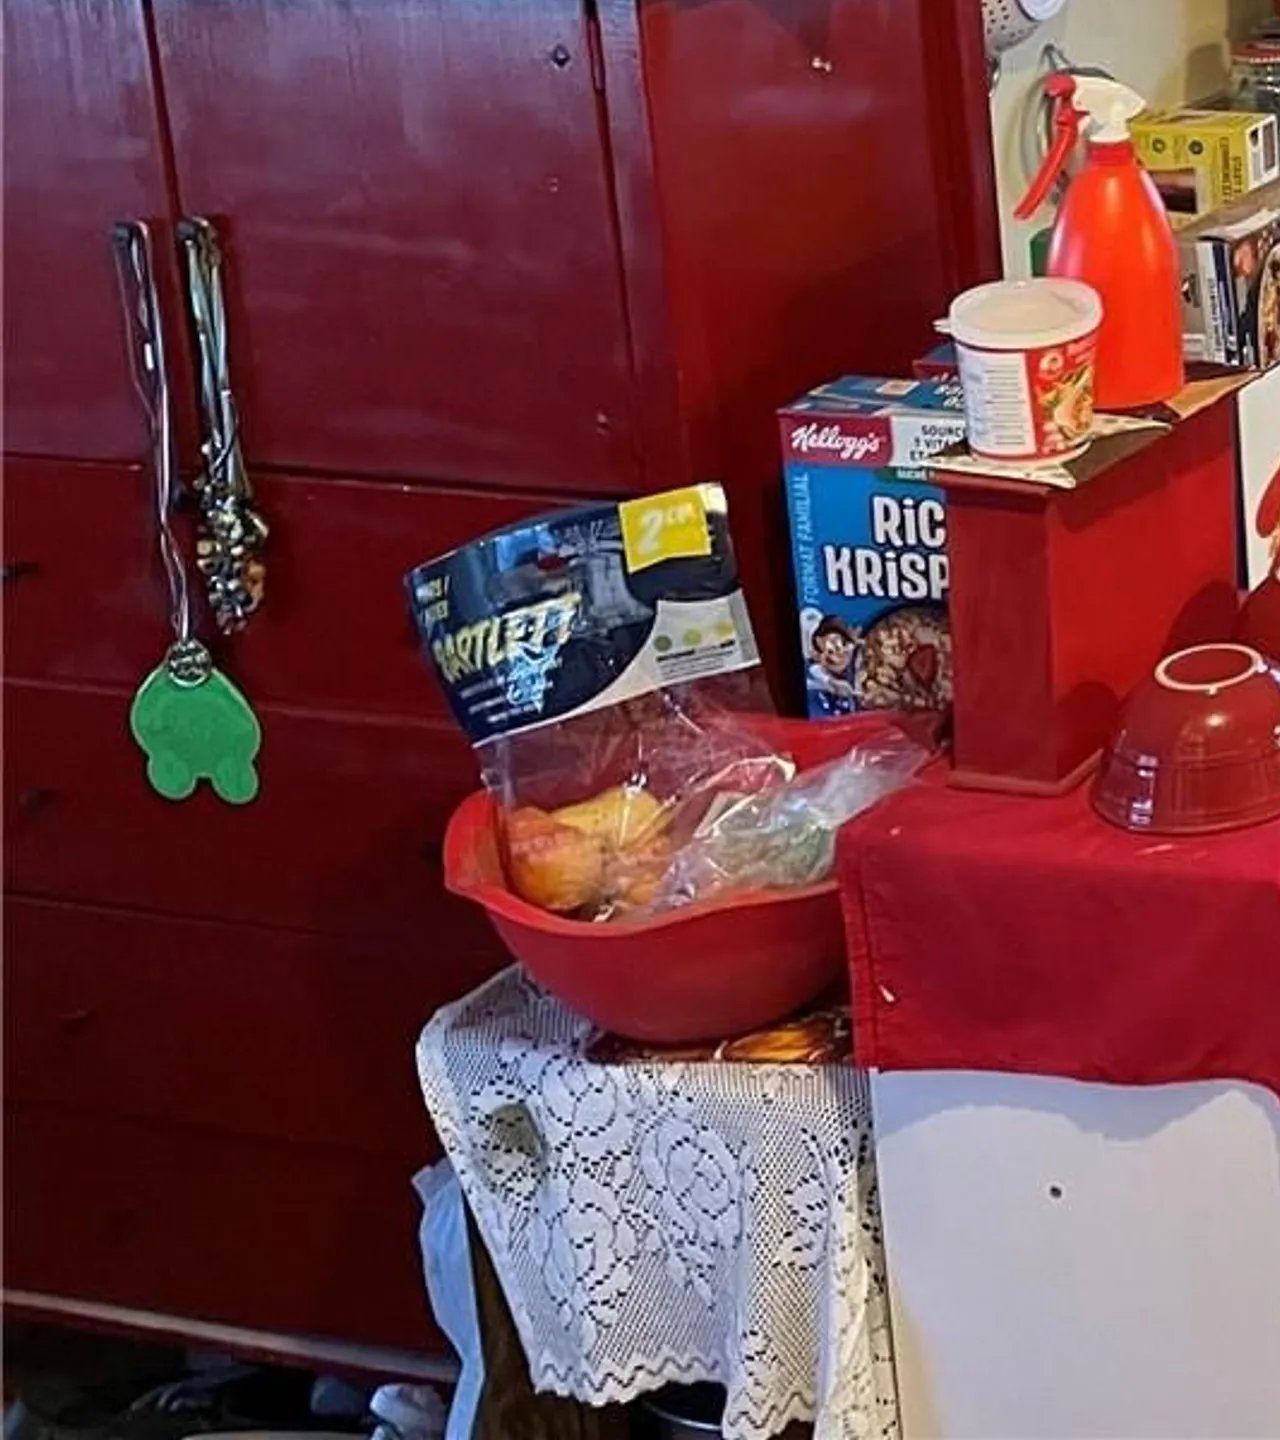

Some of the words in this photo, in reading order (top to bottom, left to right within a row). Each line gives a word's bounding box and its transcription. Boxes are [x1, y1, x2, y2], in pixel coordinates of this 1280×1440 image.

[790, 421, 881, 460] Kellogg's
[792, 471, 814, 542] FAMILIAL
[798, 544, 820, 606] FORMAT
